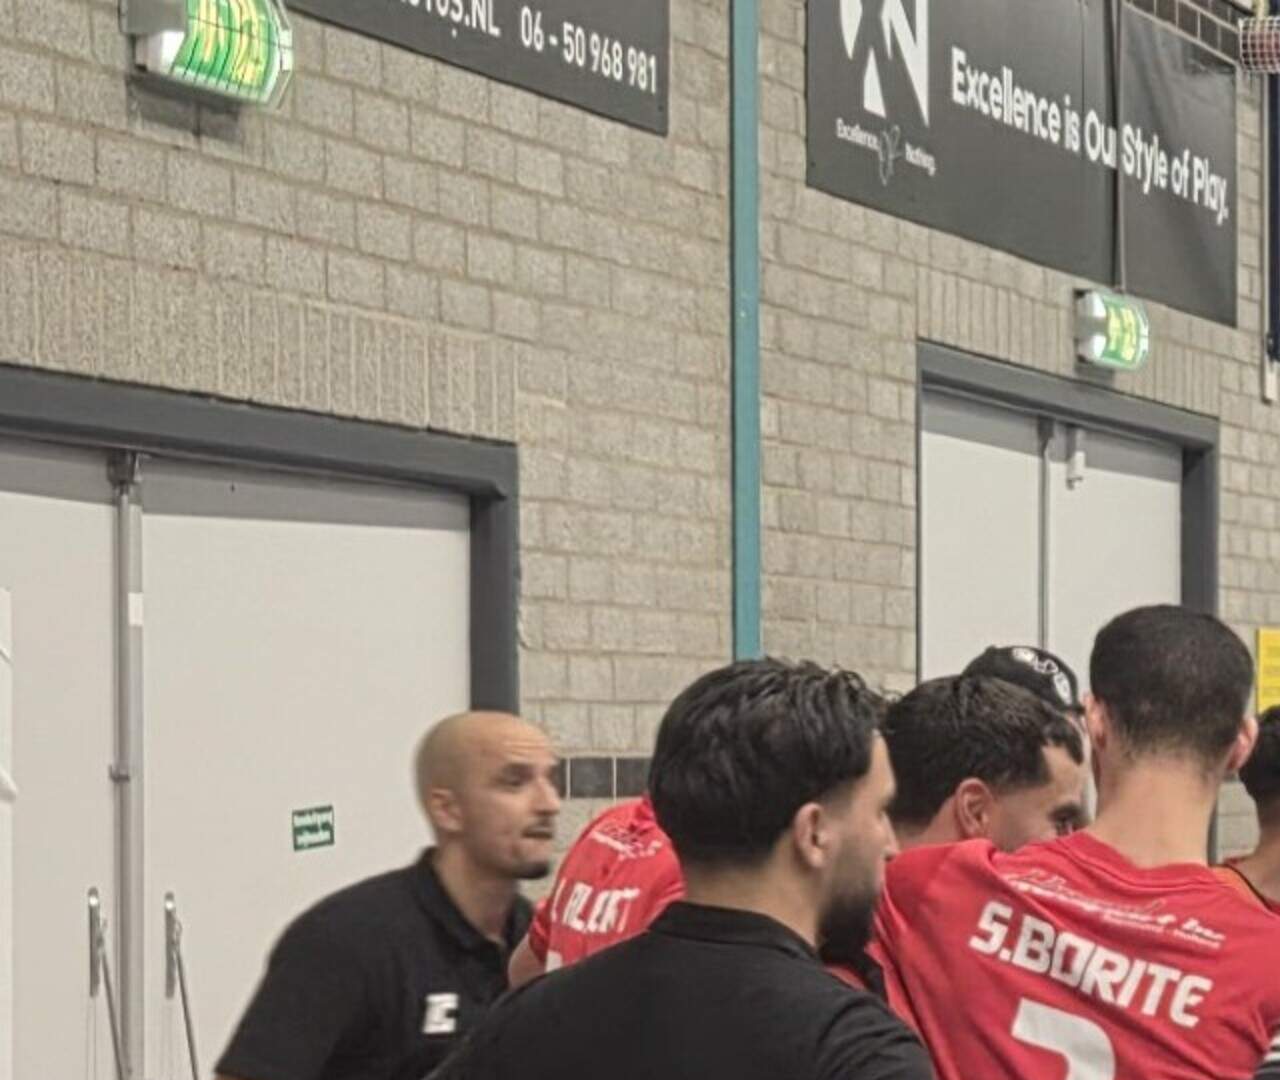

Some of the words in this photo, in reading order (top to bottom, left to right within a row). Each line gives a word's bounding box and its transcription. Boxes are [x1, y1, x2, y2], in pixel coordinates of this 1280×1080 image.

[520, 6, 544, 52] 06
[562, 21, 586, 67] 50
[589, 32, 623, 81] 968
[626, 46, 657, 94] 981
[950, 46, 1061, 143] Excellence
[1064, 94, 1081, 152] is
[1121, 124, 1167, 194] Style
[1171, 148, 1191, 199] of
[1193, 156, 1229, 225] Play.
[968, 900, 1213, 1030] S.BORITE
